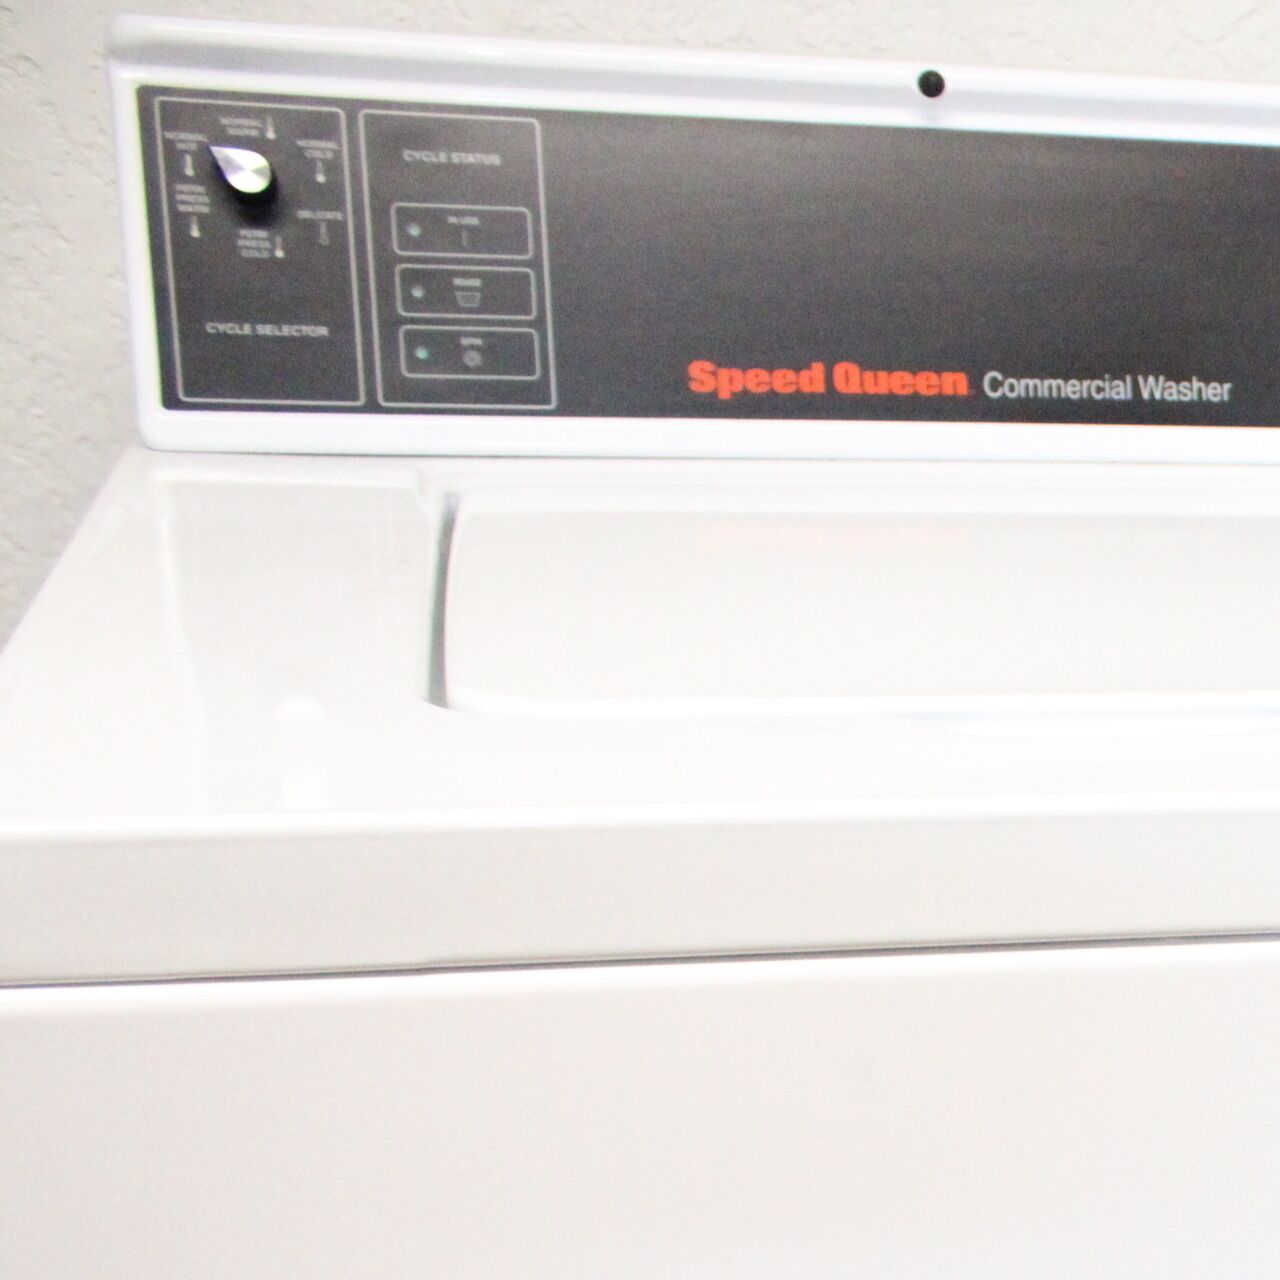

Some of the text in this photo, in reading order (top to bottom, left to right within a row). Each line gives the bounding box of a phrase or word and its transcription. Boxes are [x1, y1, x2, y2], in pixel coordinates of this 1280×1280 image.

[402, 149, 501, 166] CYCLE STATUS
[205, 322, 329, 337] CYCLE SELECTOR
[688, 360, 968, 399] Speed Queen
[982, 370, 1232, 402] Commercial Washer
